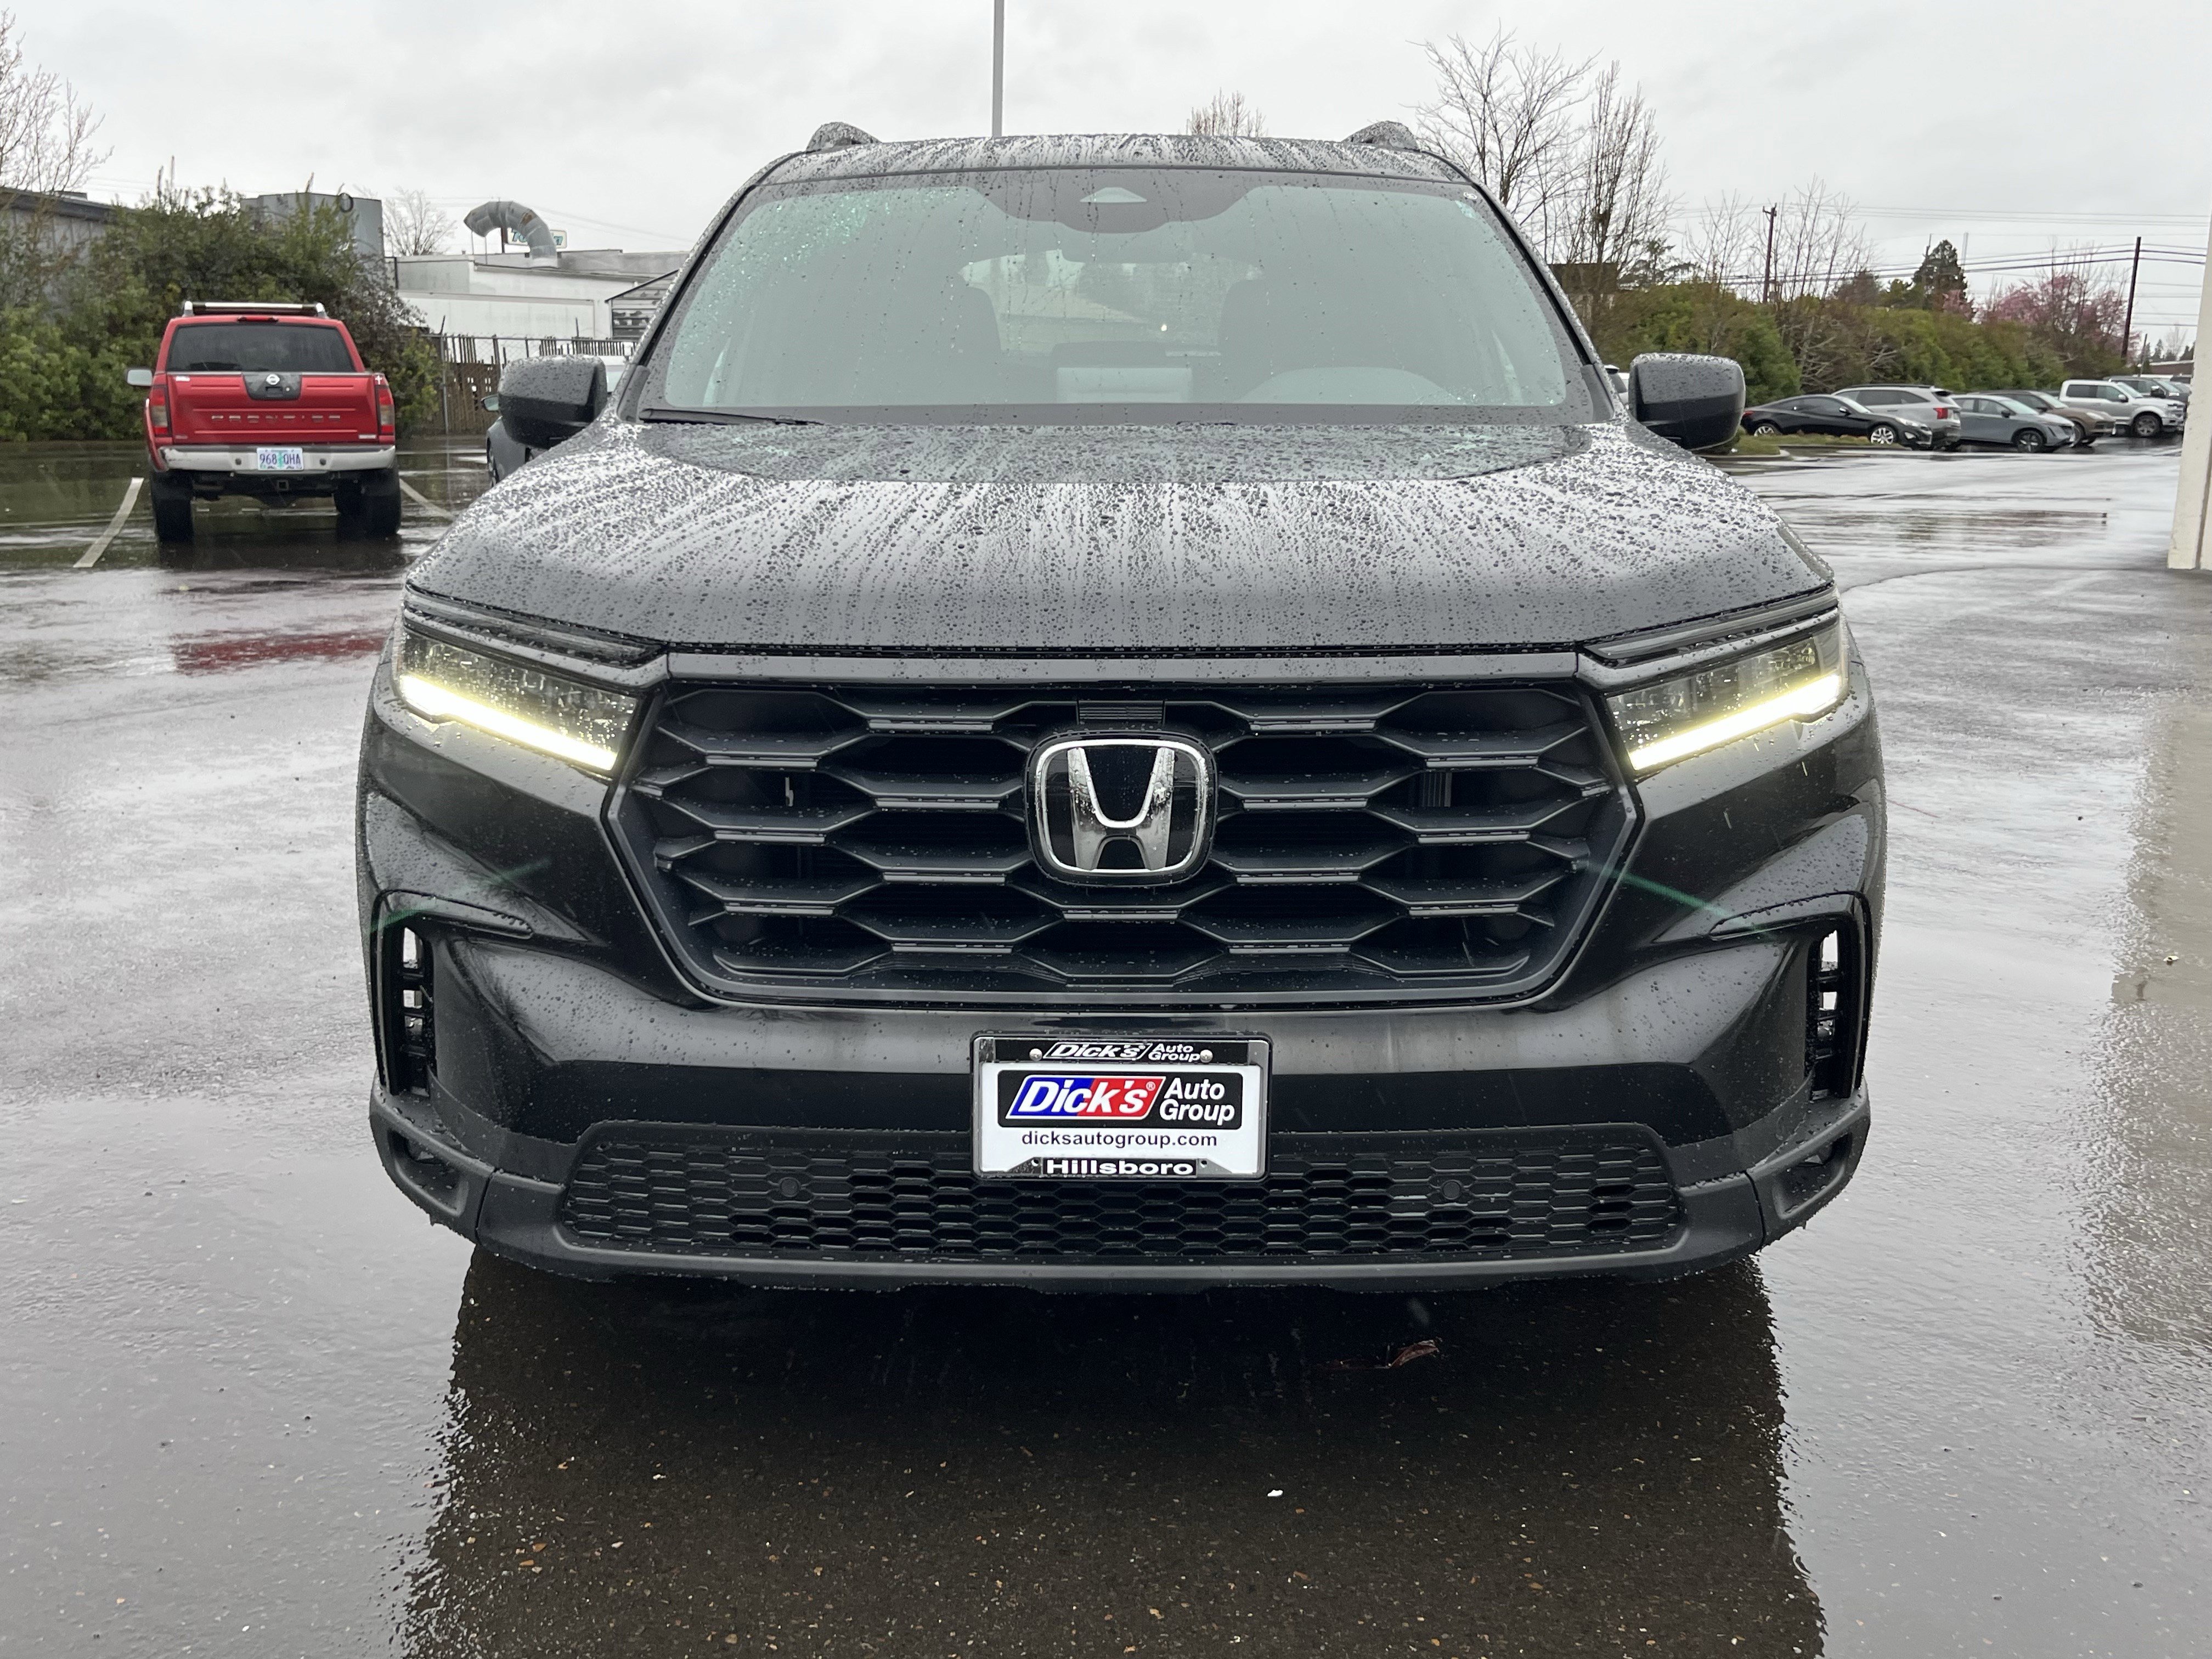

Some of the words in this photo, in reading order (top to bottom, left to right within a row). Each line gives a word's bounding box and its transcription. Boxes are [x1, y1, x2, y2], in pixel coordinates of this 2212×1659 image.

[259, 454, 277, 465] 968
[283, 453, 301, 465] QHA
[1148, 1051, 1201, 1062] Group
[1153, 1043, 1194, 1053] Auto
[1164, 1077, 1225, 1100] Auto
[1159, 1099, 1235, 1126] Group
[1022, 1131, 1217, 1149] dicksautogroup.com
[1046, 1159, 1194, 1176] Hillsboro
